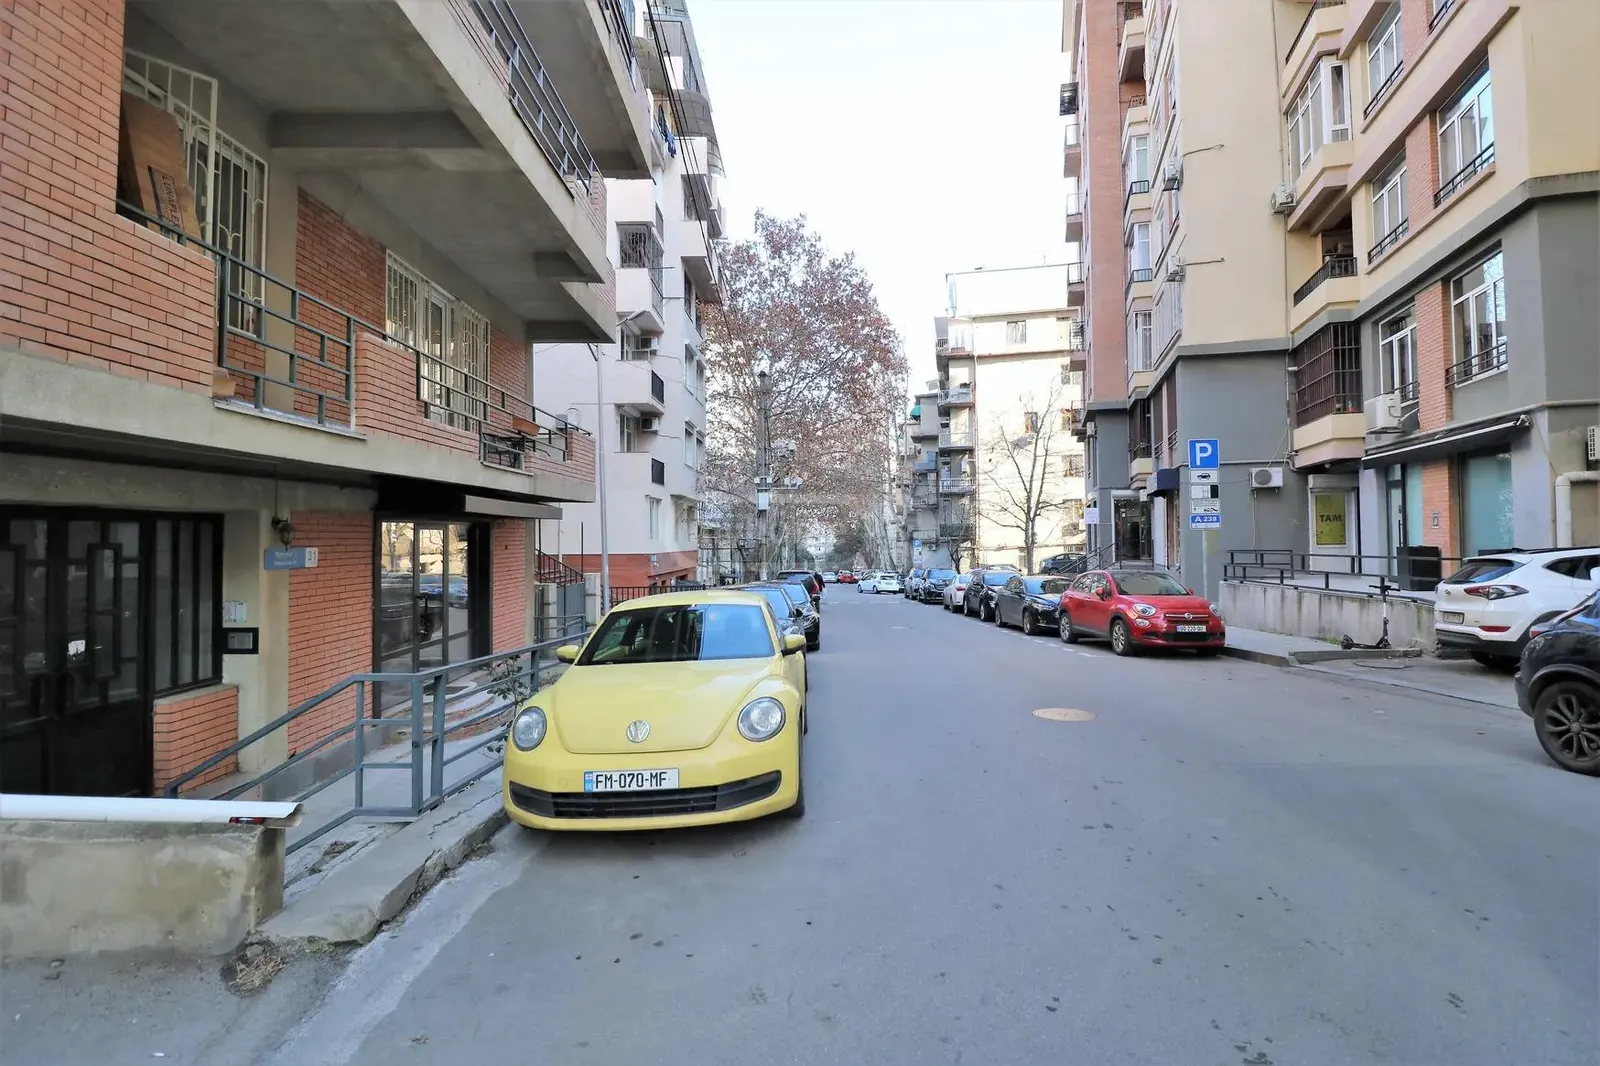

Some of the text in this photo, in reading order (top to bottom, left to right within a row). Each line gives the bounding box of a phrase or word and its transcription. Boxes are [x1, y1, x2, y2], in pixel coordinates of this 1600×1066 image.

[161, 175, 180, 224] LUNAFLE
[1195, 442, 1212, 466] P
[1318, 513, 1343, 523] TAM
[595, 771, 668, 790] FM-070-MF
